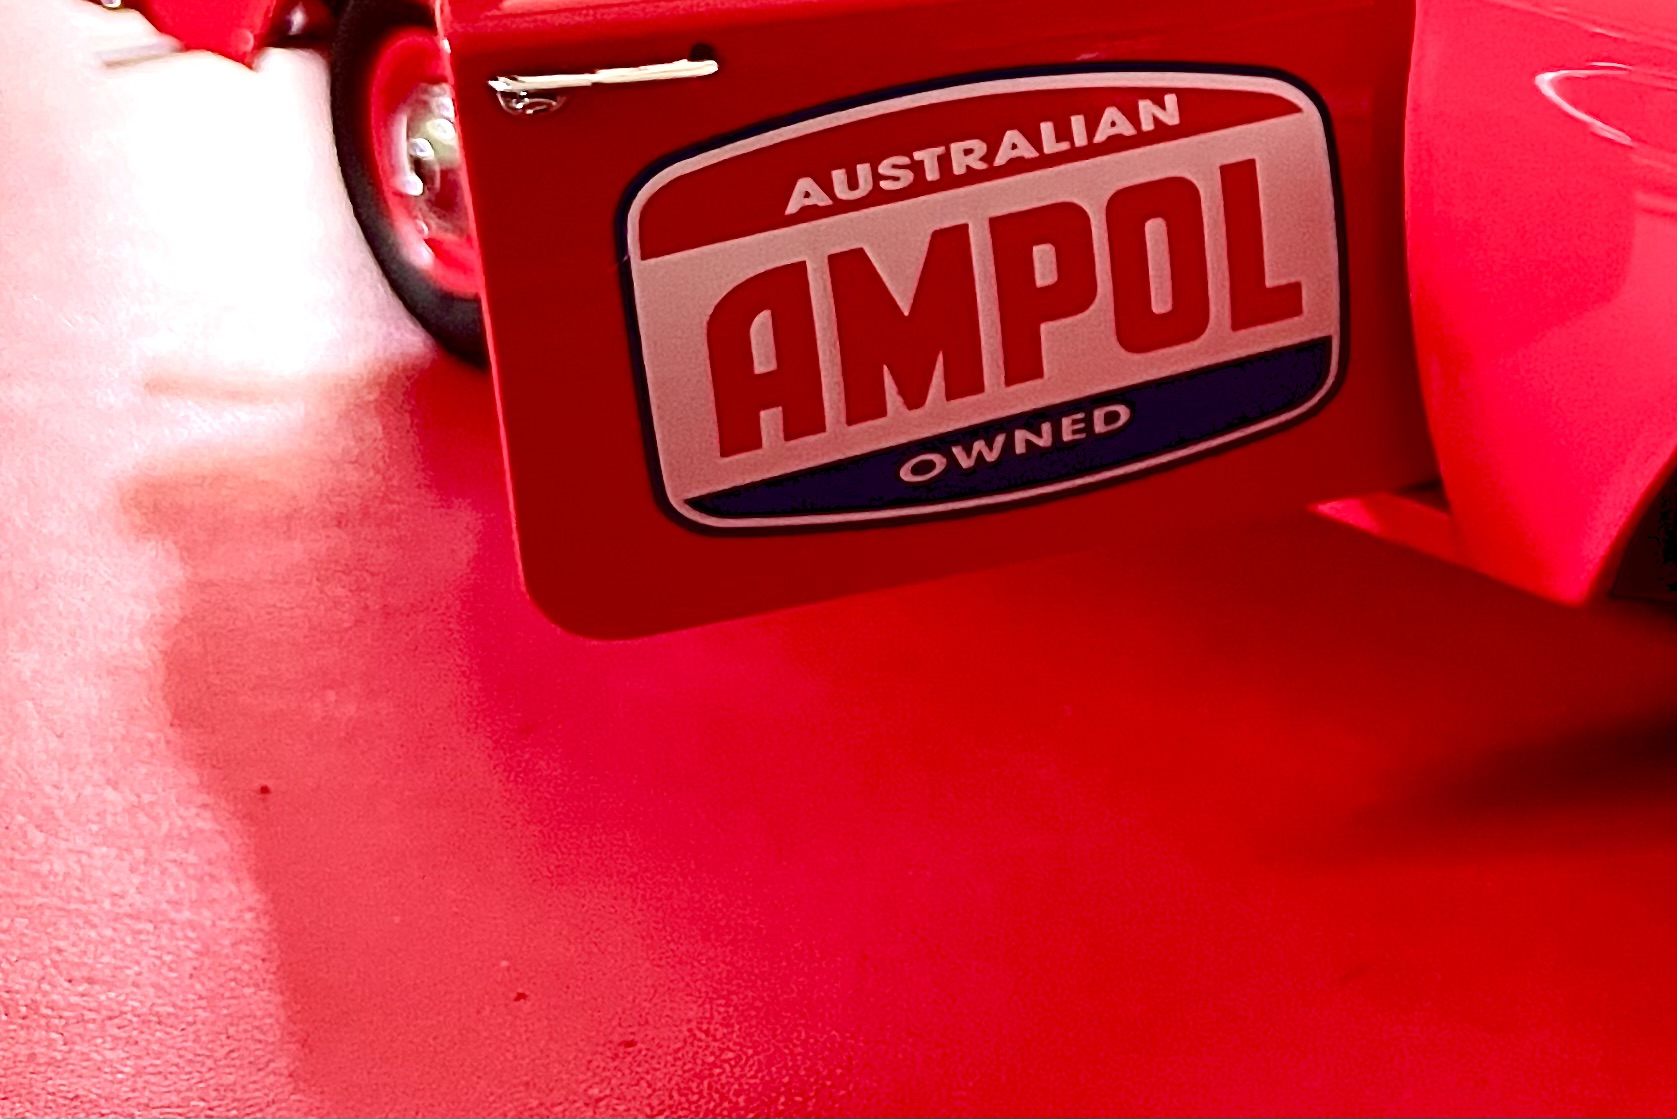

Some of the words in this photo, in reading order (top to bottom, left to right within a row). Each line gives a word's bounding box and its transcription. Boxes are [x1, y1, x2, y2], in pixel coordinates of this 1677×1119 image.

[785, 93, 1181, 216] AUSTRALIAN
[706, 158, 1304, 459] AMPOL
[898, 403, 1133, 484] OWNED
